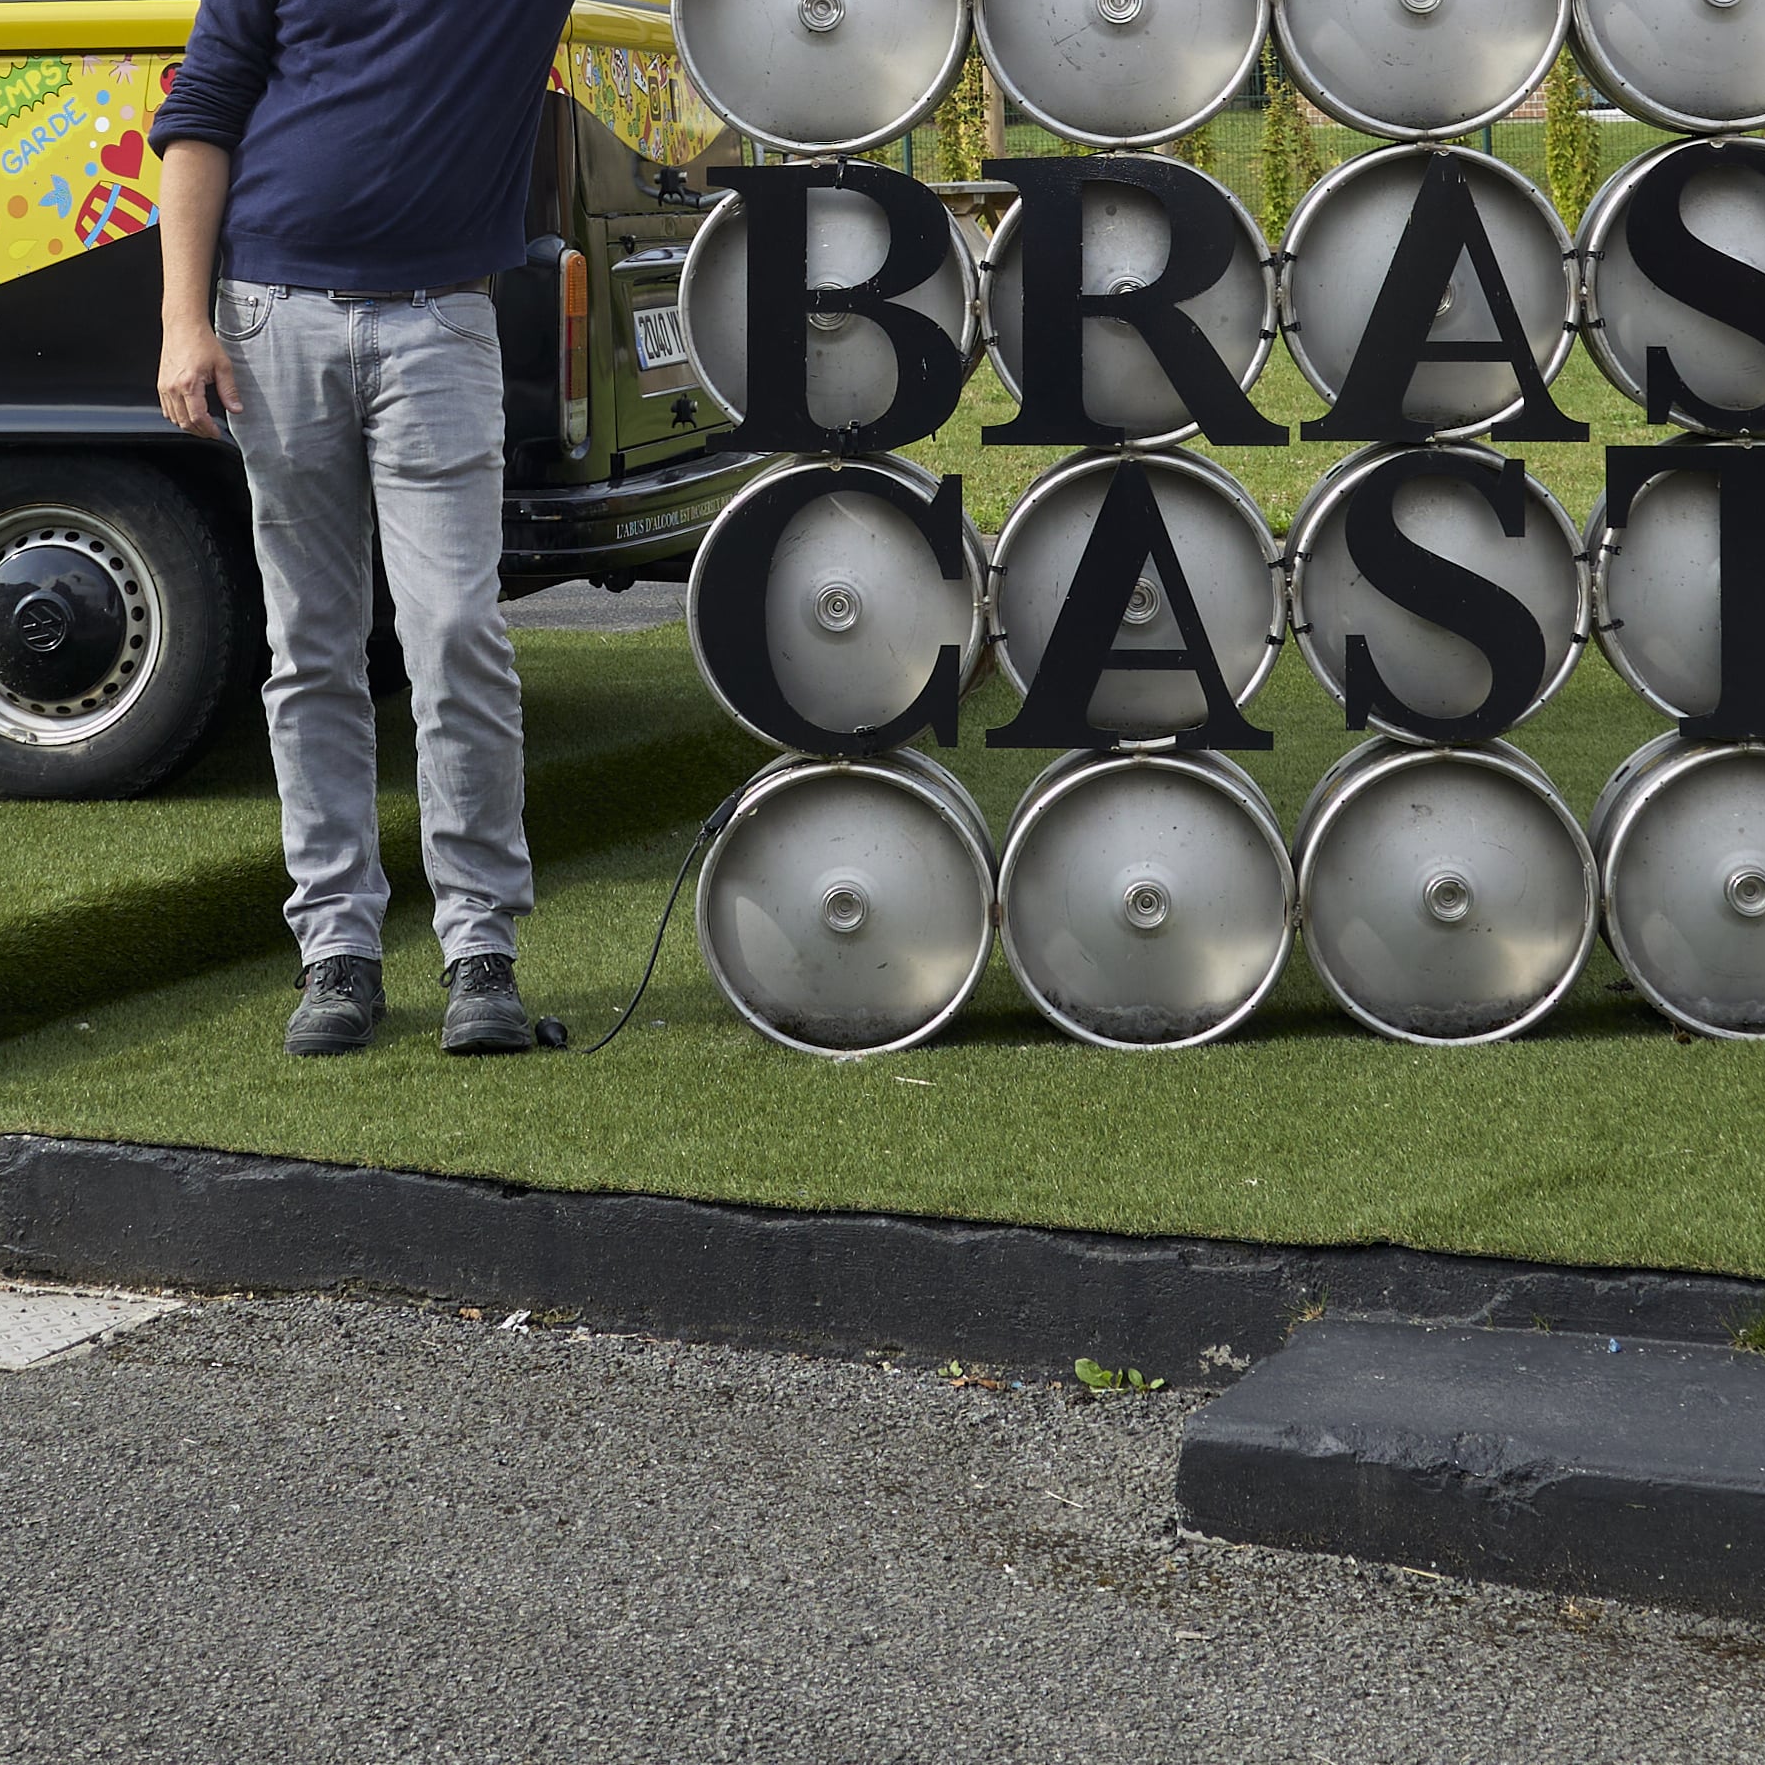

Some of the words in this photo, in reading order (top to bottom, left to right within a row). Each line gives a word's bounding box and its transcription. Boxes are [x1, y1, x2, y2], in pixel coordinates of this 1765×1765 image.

[1, 96, 88, 174] GARDE
[638, 312, 673, 360] 2040
[616, 519, 644, 540] L'ABUS
[645, 511, 680, 533] D'ALCOOL
